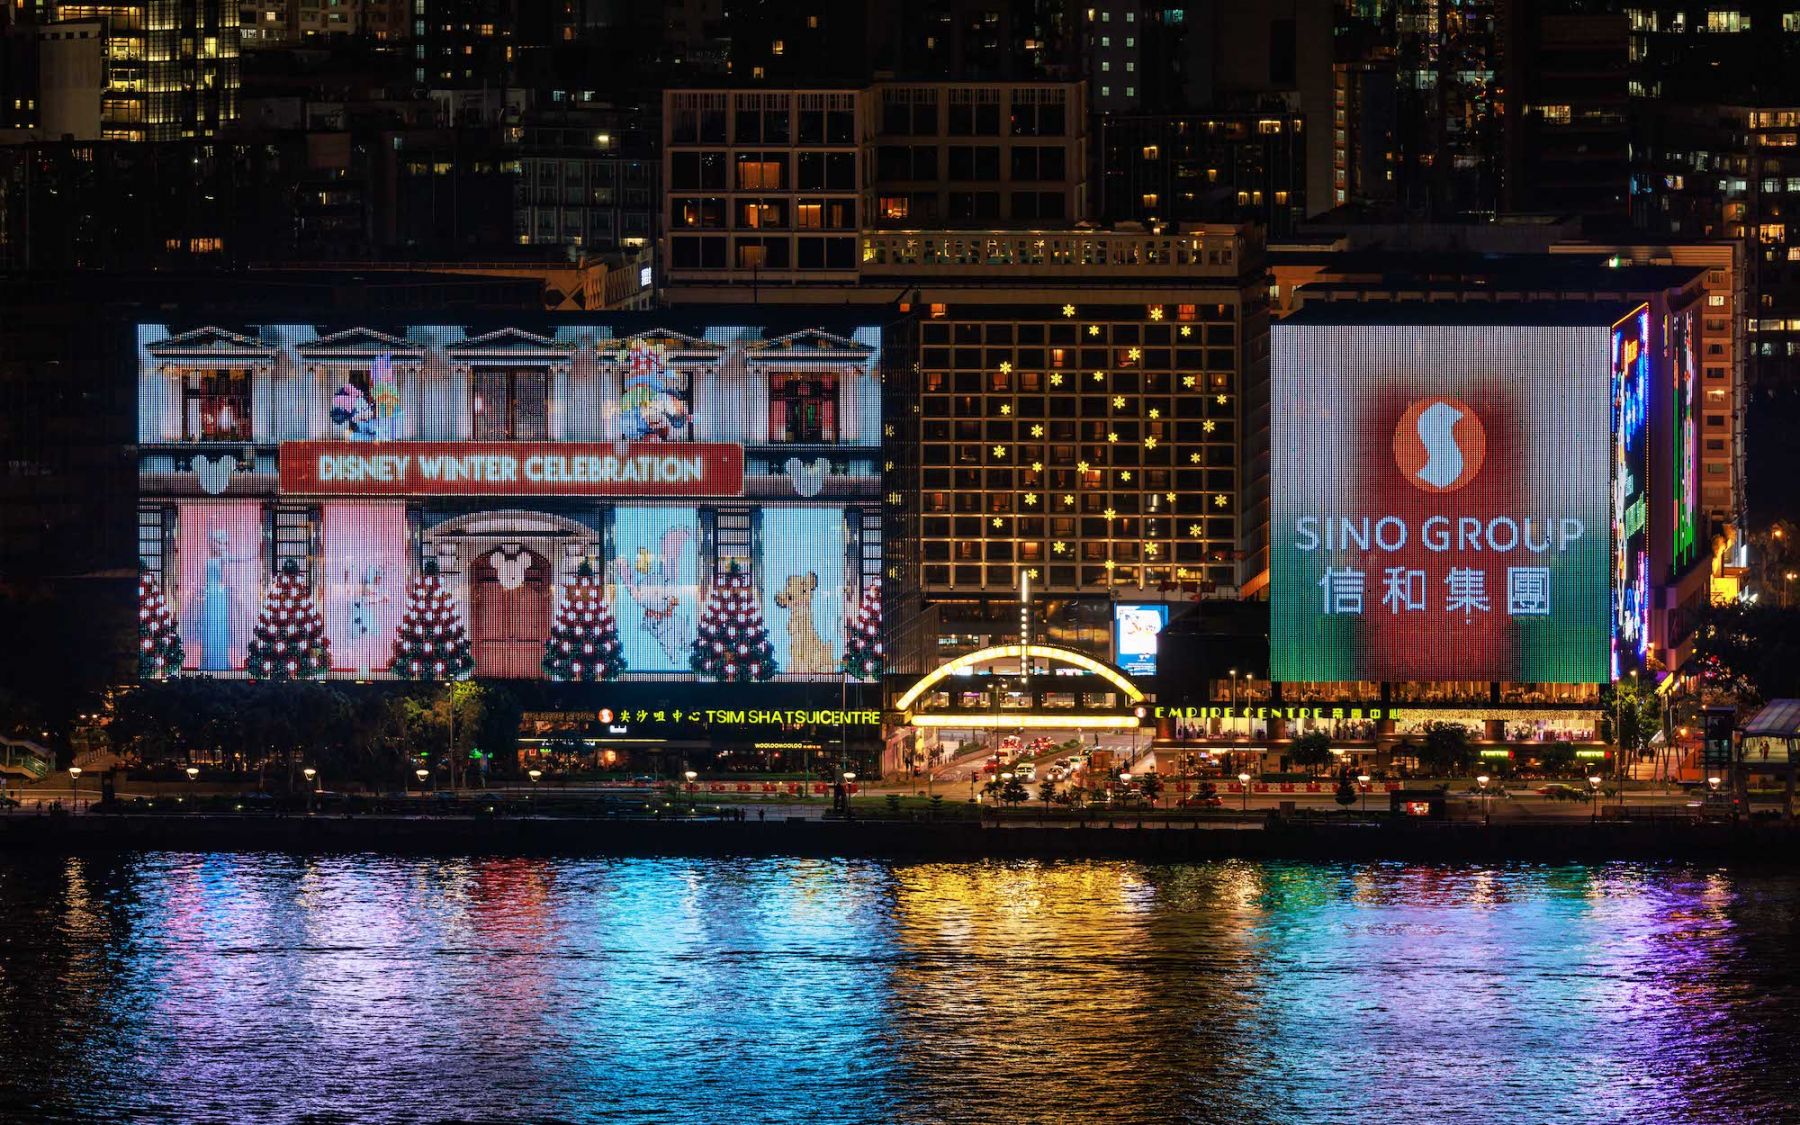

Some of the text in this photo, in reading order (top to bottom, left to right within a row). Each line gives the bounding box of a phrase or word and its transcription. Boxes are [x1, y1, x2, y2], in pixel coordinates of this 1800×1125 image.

[318, 455, 703, 482] DISNEY WINTER CELEBRATION
[1295, 515, 1408, 552] SINO
[1421, 515, 1585, 552] GROUP
[1318, 565, 1551, 616] 信和集團
[705, 710, 745, 725] TSIM
[1155, 707, 1323, 719] EMPIRE CENTRE
